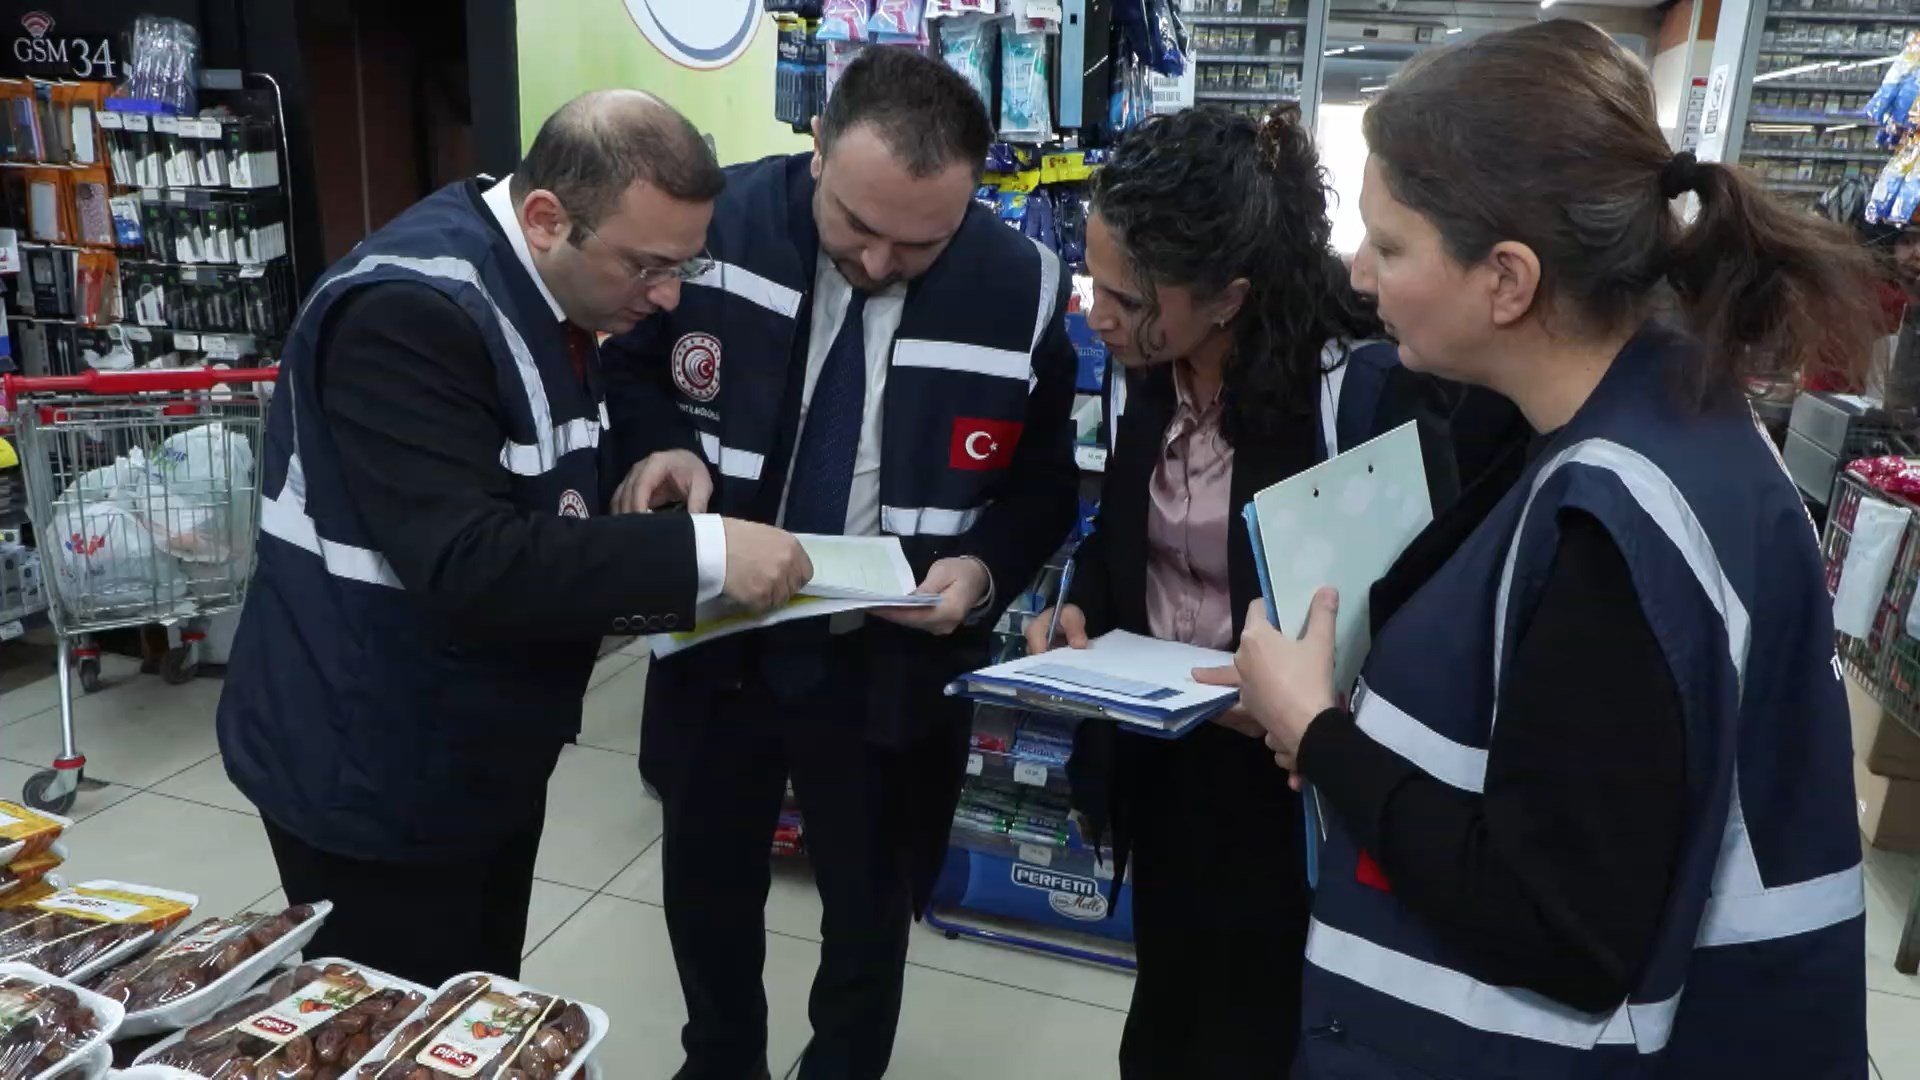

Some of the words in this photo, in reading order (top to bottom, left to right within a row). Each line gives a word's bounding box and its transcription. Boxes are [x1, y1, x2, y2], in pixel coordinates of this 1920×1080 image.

[13, 37, 68, 62] GSM
[71, 38, 116, 78] 34
[1016, 869, 1094, 895] PERFETTI
